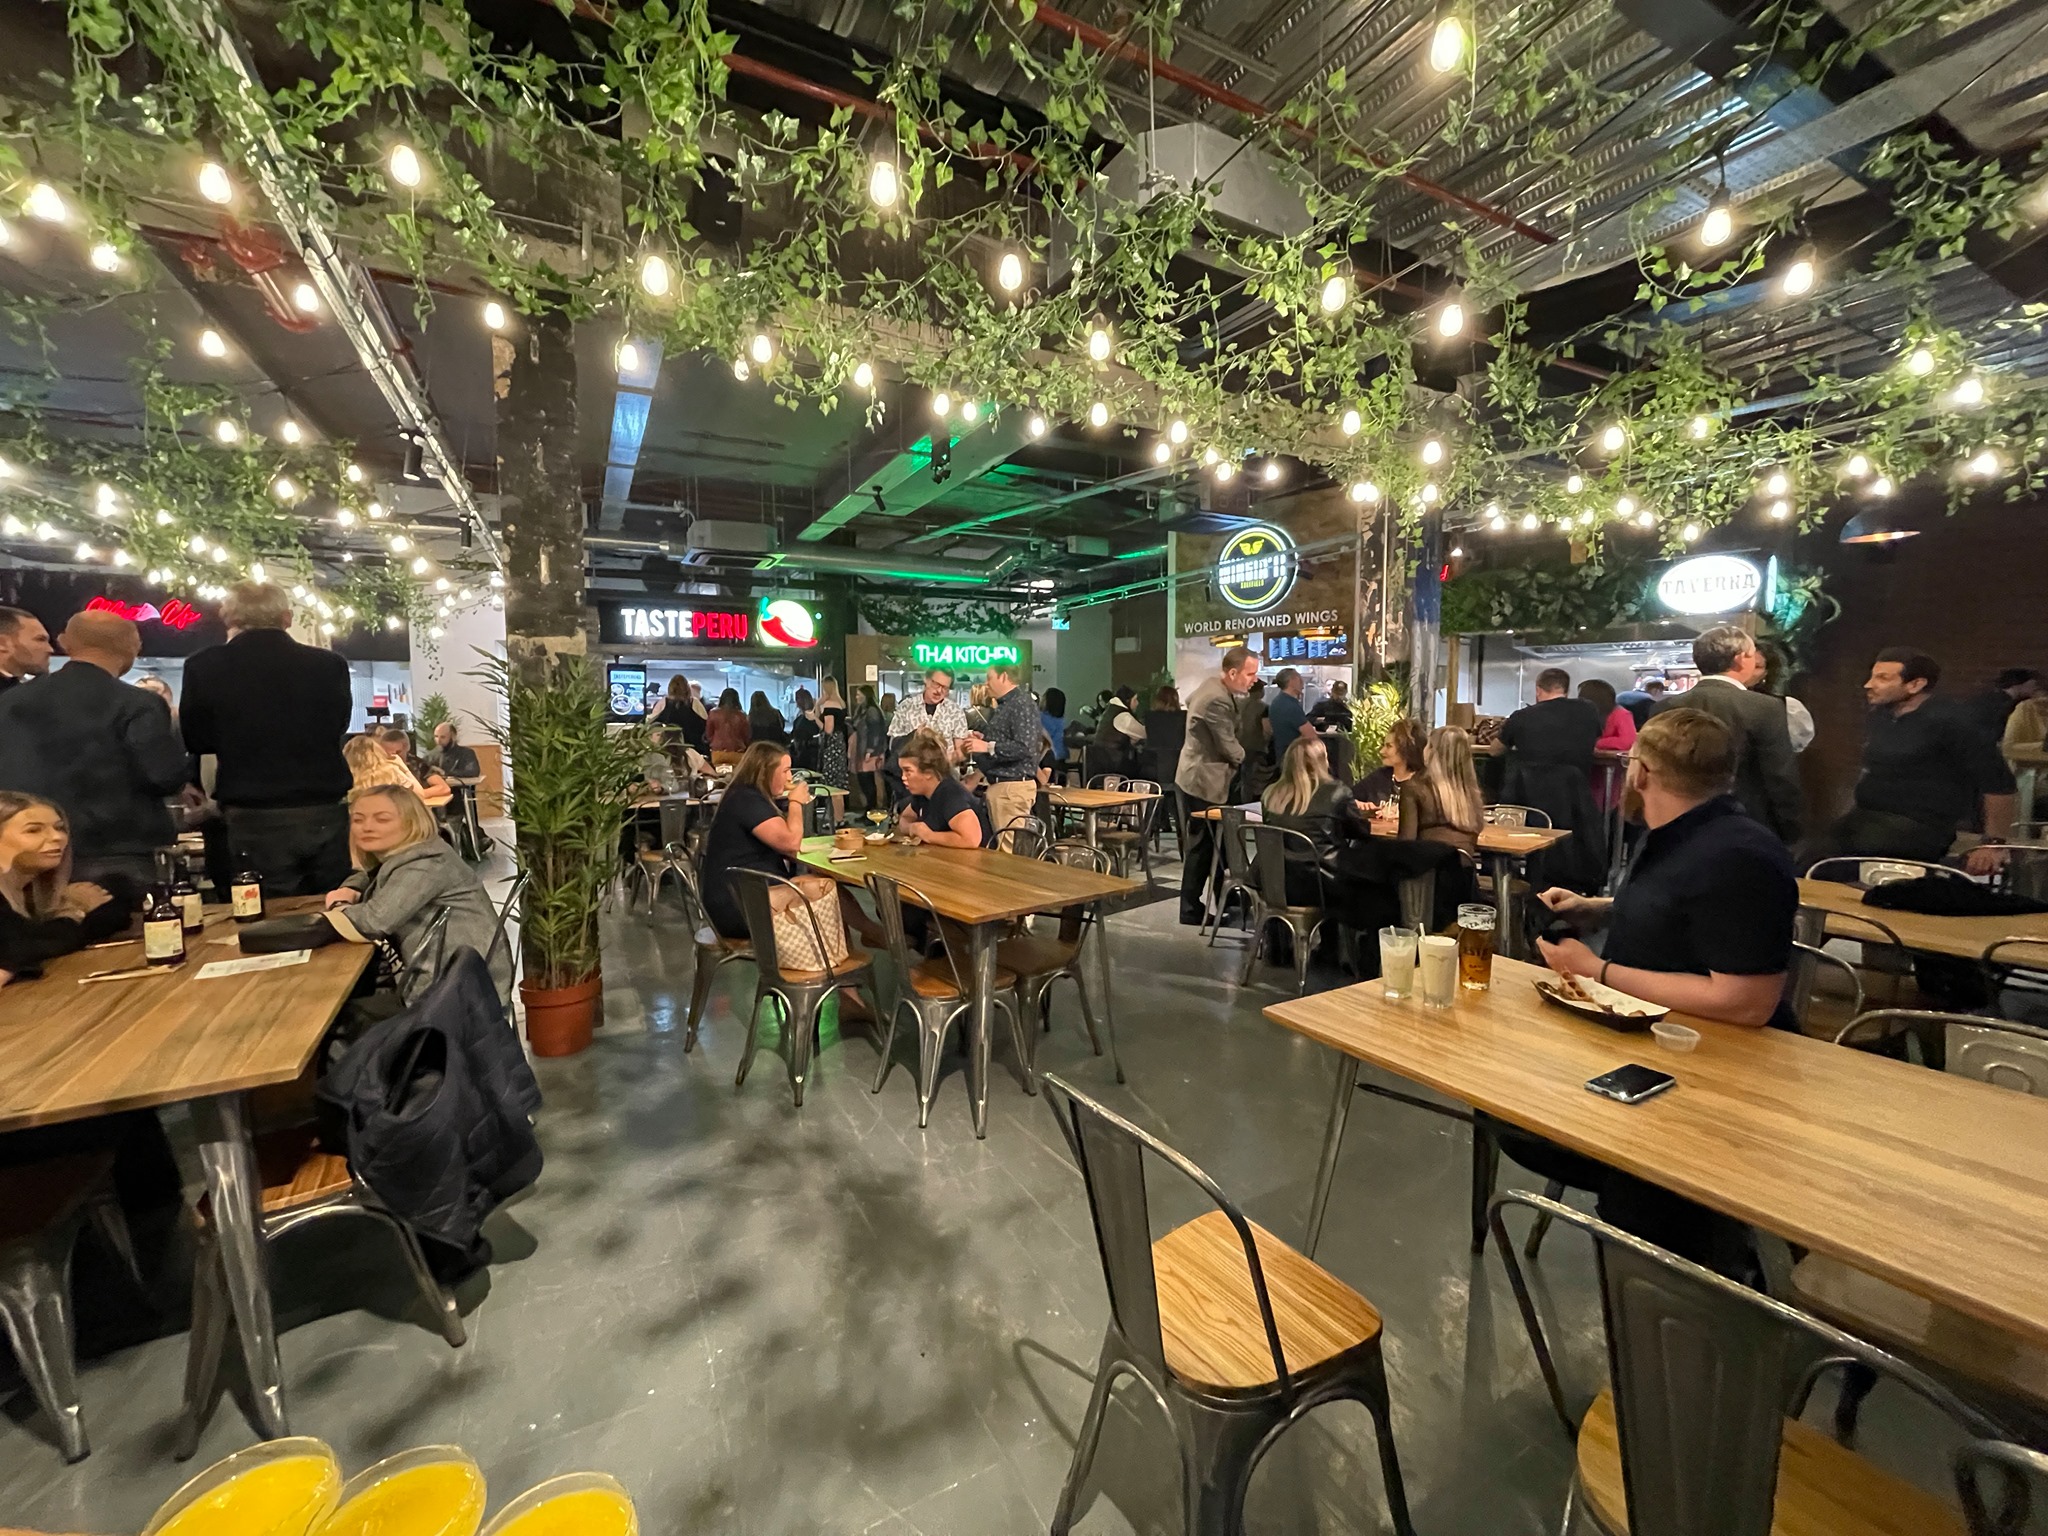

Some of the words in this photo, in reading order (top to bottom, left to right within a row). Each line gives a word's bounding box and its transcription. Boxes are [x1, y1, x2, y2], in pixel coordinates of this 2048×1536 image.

[1662, 573, 1756, 595] TAVERNA
[1184, 621, 1222, 634] WORLD
[1225, 614, 1291, 631] RENOWNED
[1295, 609, 1339, 624] WINGS
[955, 645, 1017, 665] KITCHEN
